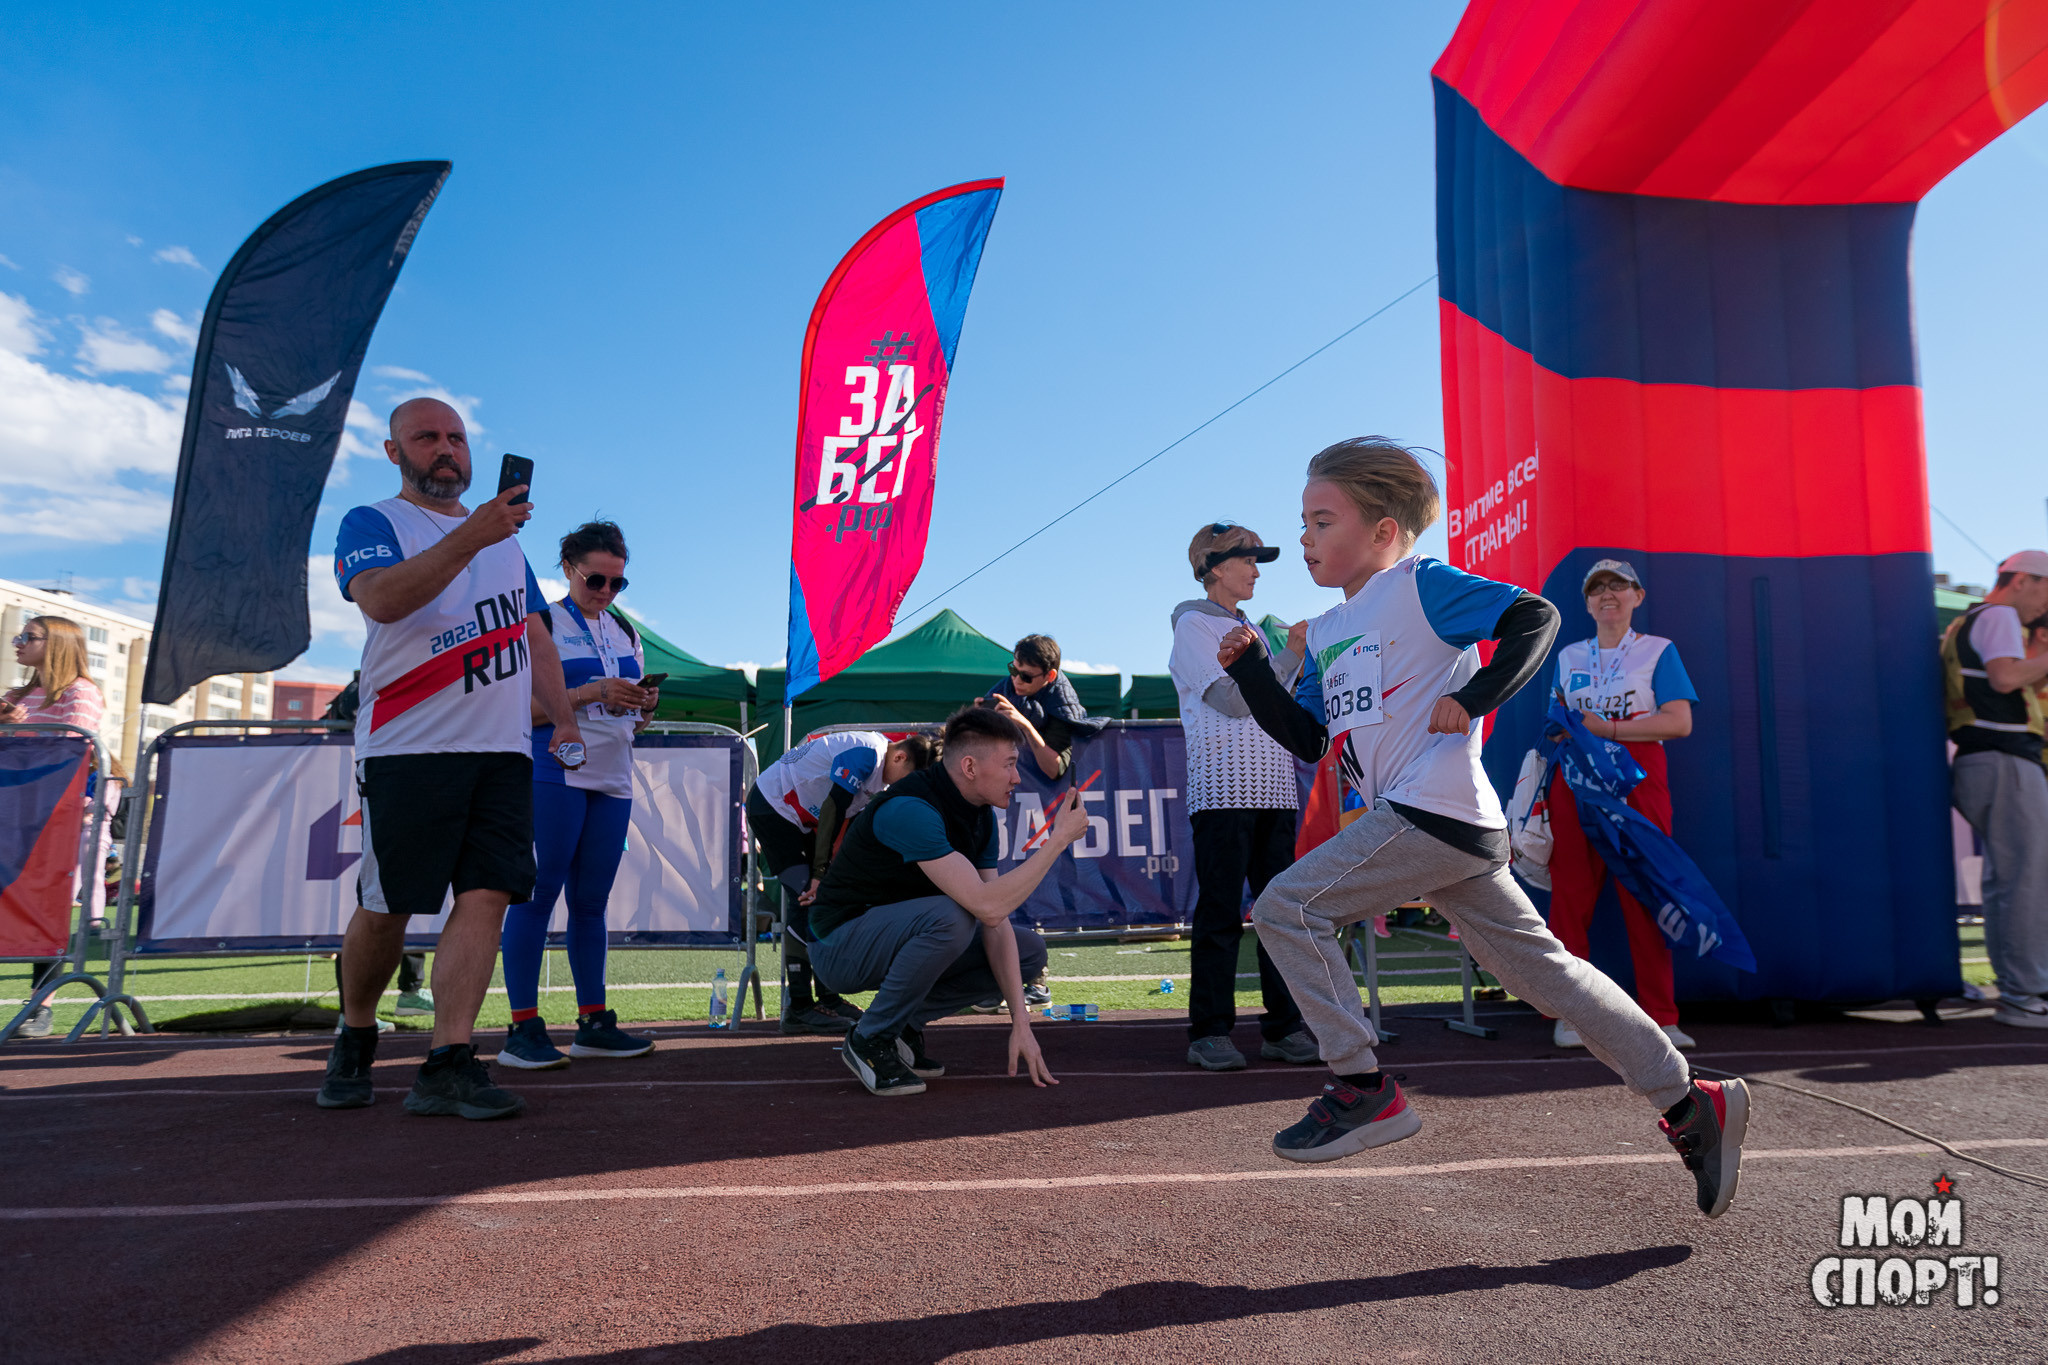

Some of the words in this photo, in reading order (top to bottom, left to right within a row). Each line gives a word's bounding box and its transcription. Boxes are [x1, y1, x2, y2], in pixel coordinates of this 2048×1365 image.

[839, 364, 917, 436] ЗА
[256, 427, 311, 442] ГЕРОЕВ
[815, 425, 925, 505] БЕГ
[1448, 508, 1462, 539] В
[1464, 479, 1504, 535] ритме
[1464, 499, 1528, 571] СТРАНЫ!
[345, 544, 393, 568] ПСБ
[430, 621, 479, 655] 2022
[1362, 644, 1379, 653] ПСБ
[463, 637, 528, 694] RUN
[1576, 696, 1622, 710] 1072
[1140, 850, 1179, 879] .рф
